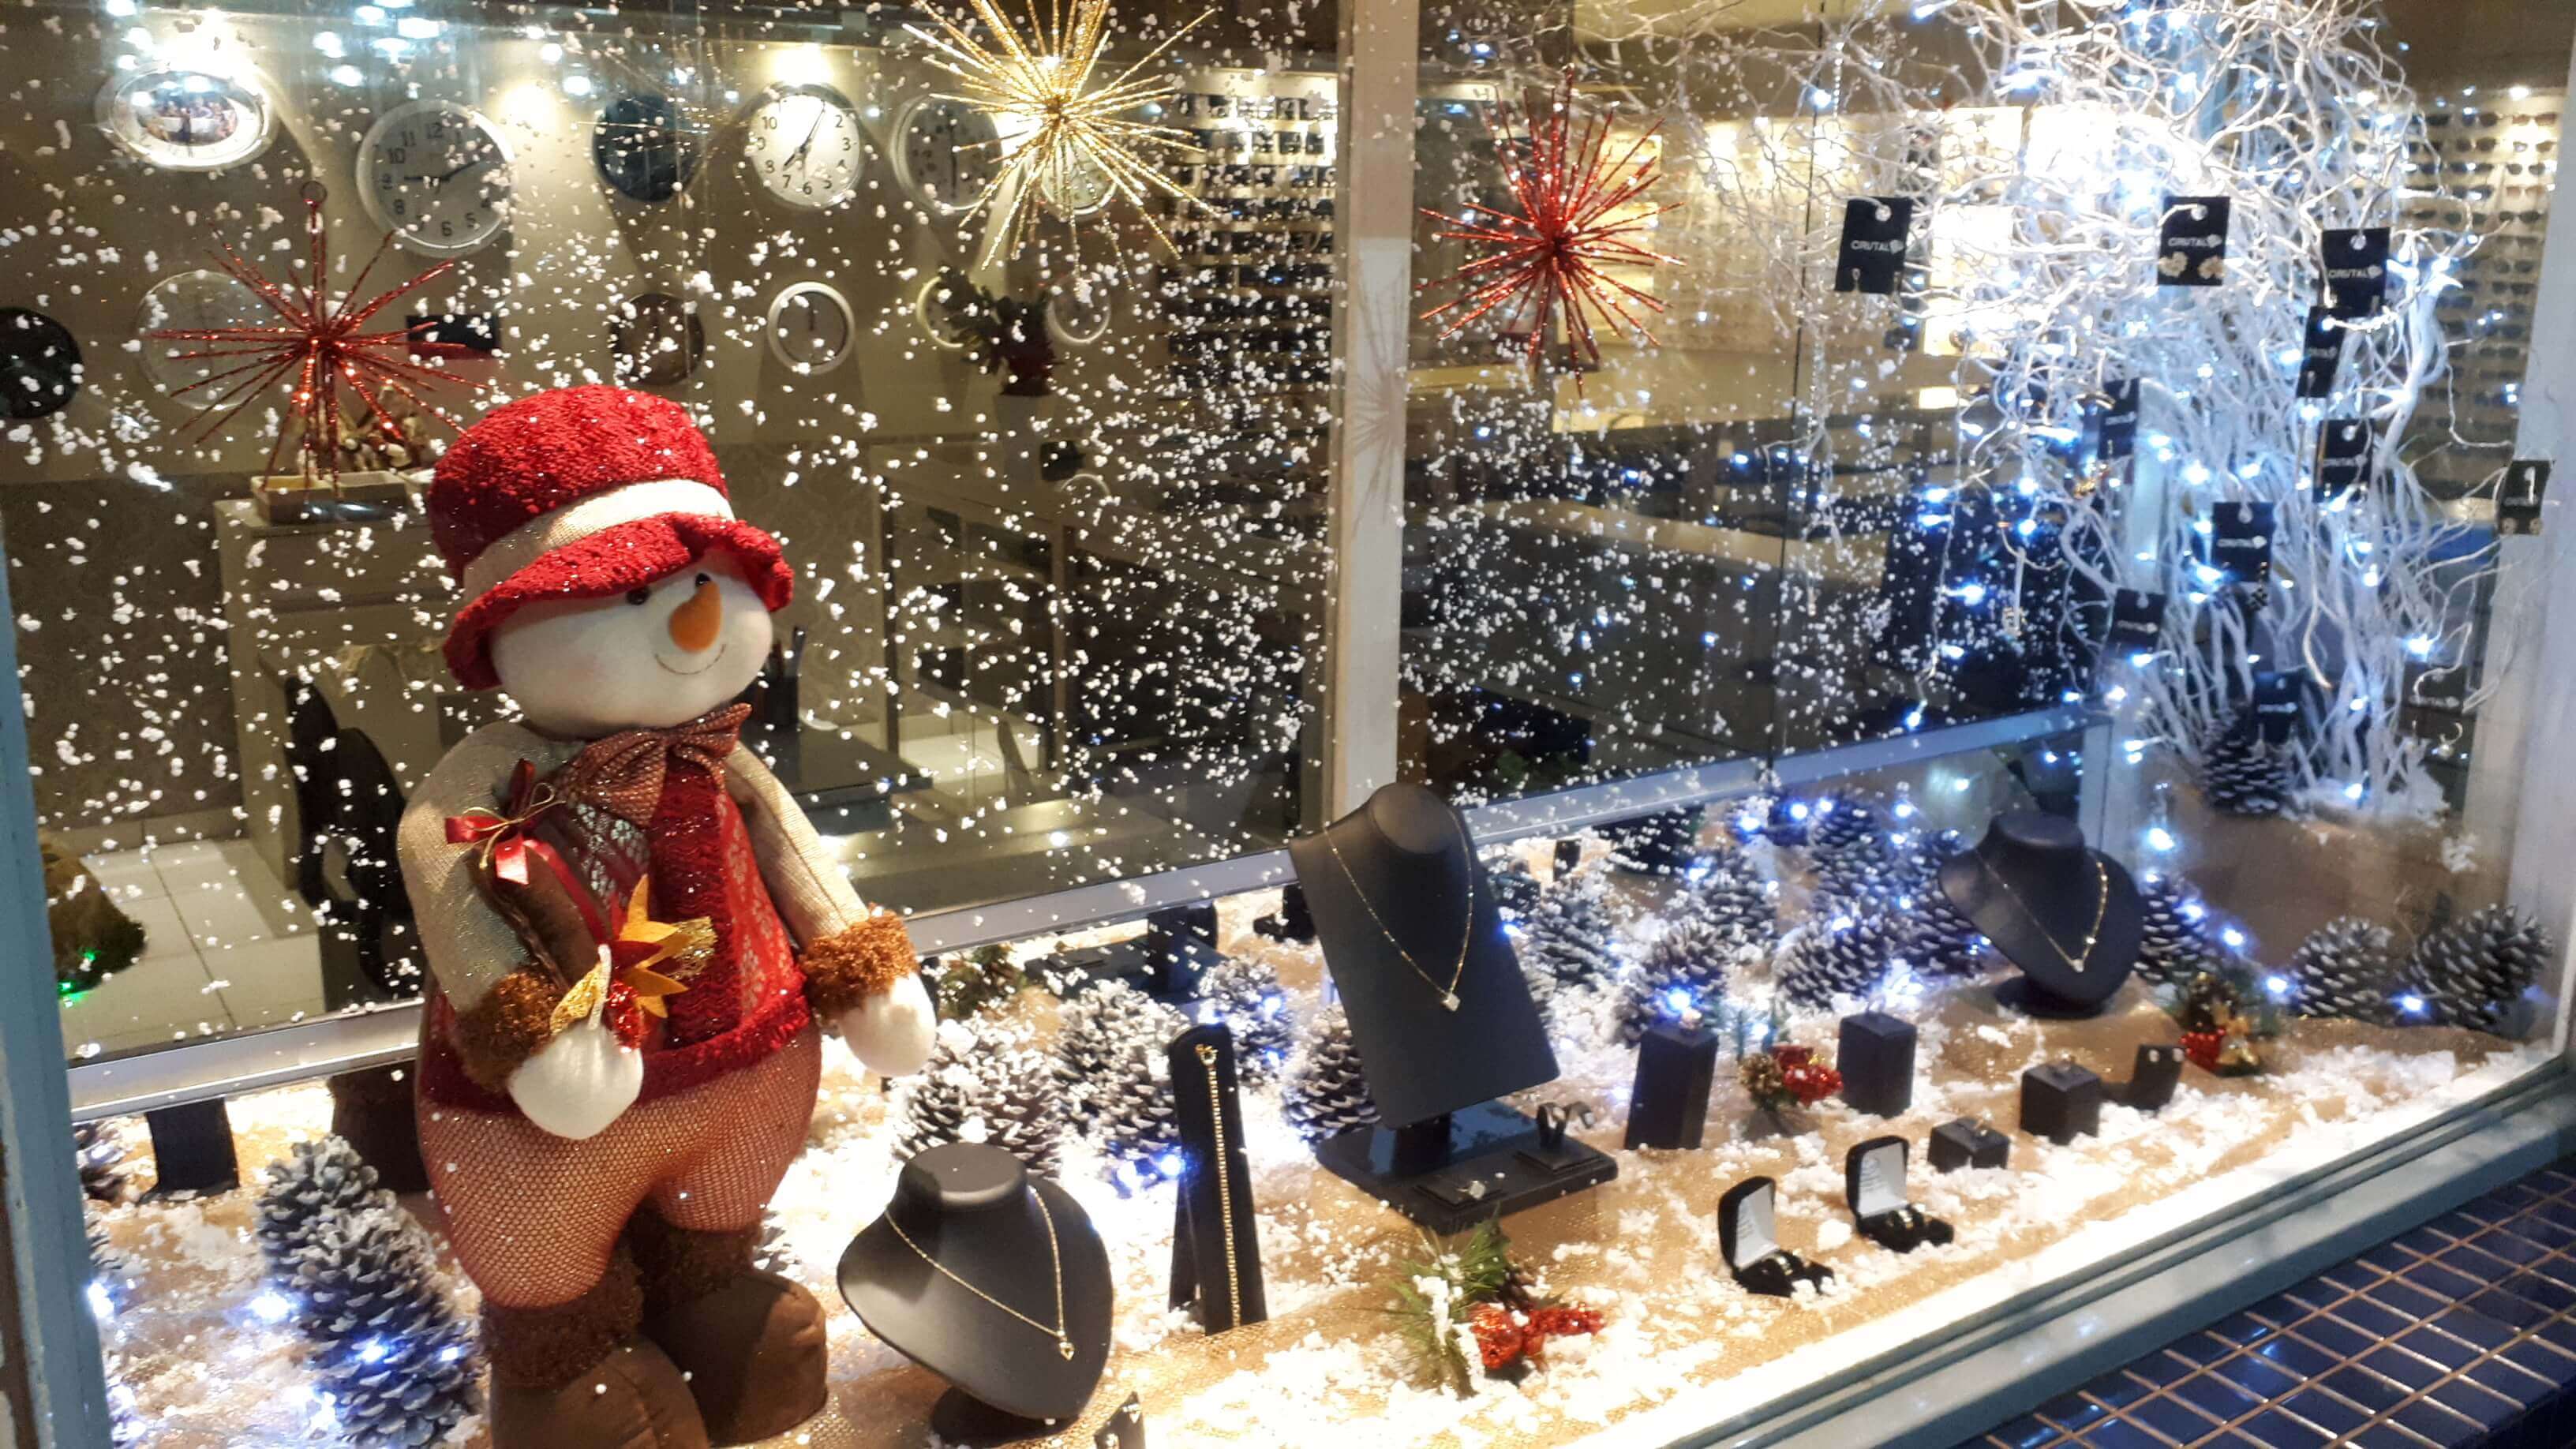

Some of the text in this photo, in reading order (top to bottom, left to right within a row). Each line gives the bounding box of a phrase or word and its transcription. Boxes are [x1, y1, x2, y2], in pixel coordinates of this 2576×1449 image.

[762, 116, 777, 130] 10
[834, 114, 844, 128] 2
[426, 122, 443, 140] 12
[400, 130, 417, 148] 11
[842, 137, 852, 151] 3
[388, 148, 406, 164] 10
[765, 159, 775, 174] 8
[782, 174, 792, 189] 7
[803, 182, 812, 195] 6
[441, 221, 452, 237] 6
